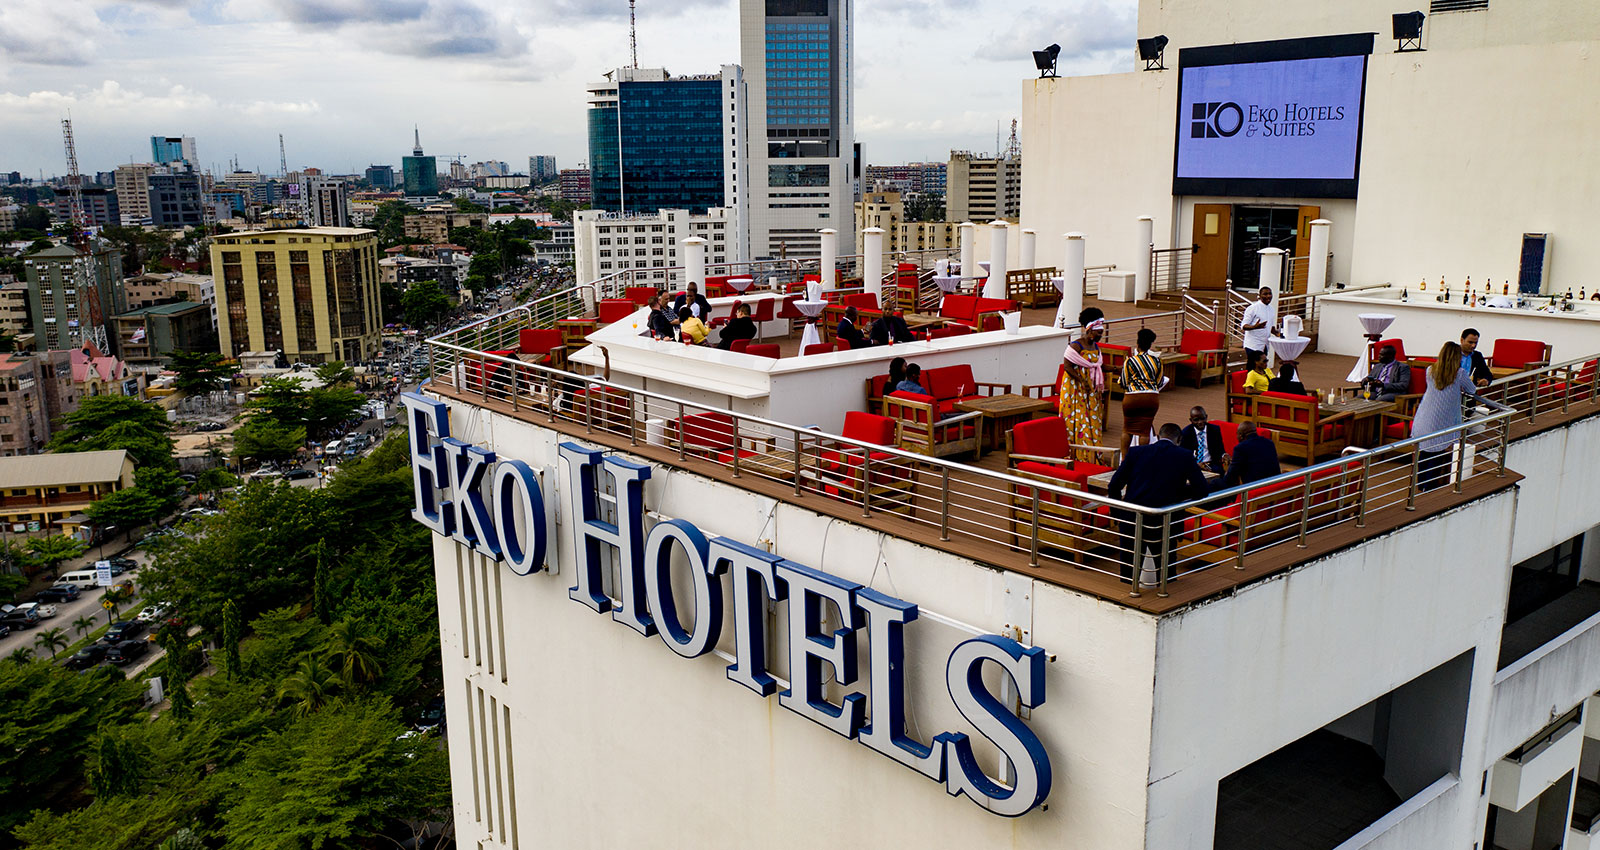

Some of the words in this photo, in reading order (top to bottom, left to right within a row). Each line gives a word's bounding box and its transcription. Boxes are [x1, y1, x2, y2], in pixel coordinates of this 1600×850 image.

[1248, 105, 1278, 122] EKO
[1284, 103, 1344, 121] HOTELS
[1246, 124, 1258, 137] &
[1262, 120, 1315, 137] SUITES
[400, 391, 547, 576] EKO
[559, 441, 1053, 818] HOTELS
